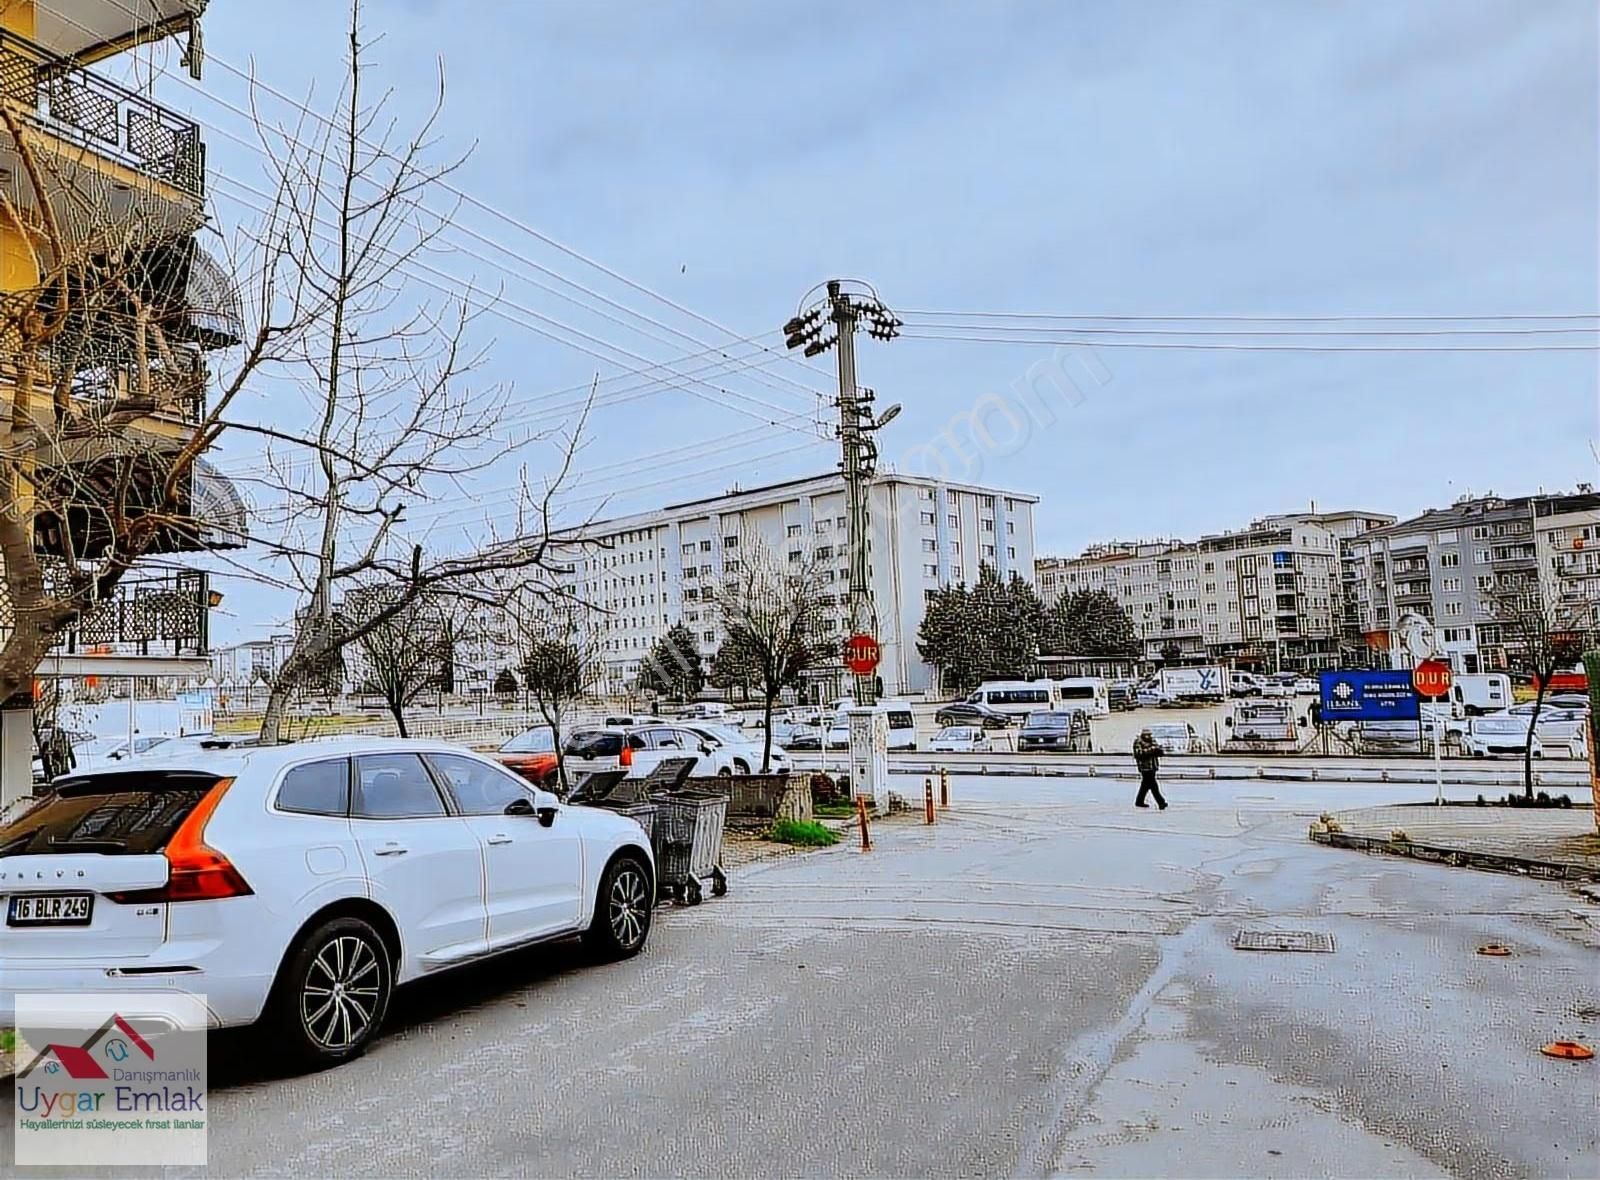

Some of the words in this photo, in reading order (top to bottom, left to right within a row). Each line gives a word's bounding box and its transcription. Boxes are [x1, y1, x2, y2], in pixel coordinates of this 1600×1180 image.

[847, 646, 878, 662] DUR
[1416, 672, 1449, 685] DUR
[17, 899, 30, 918] 16
[35, 899, 61, 918] BLR
[63, 897, 88, 917] 249
